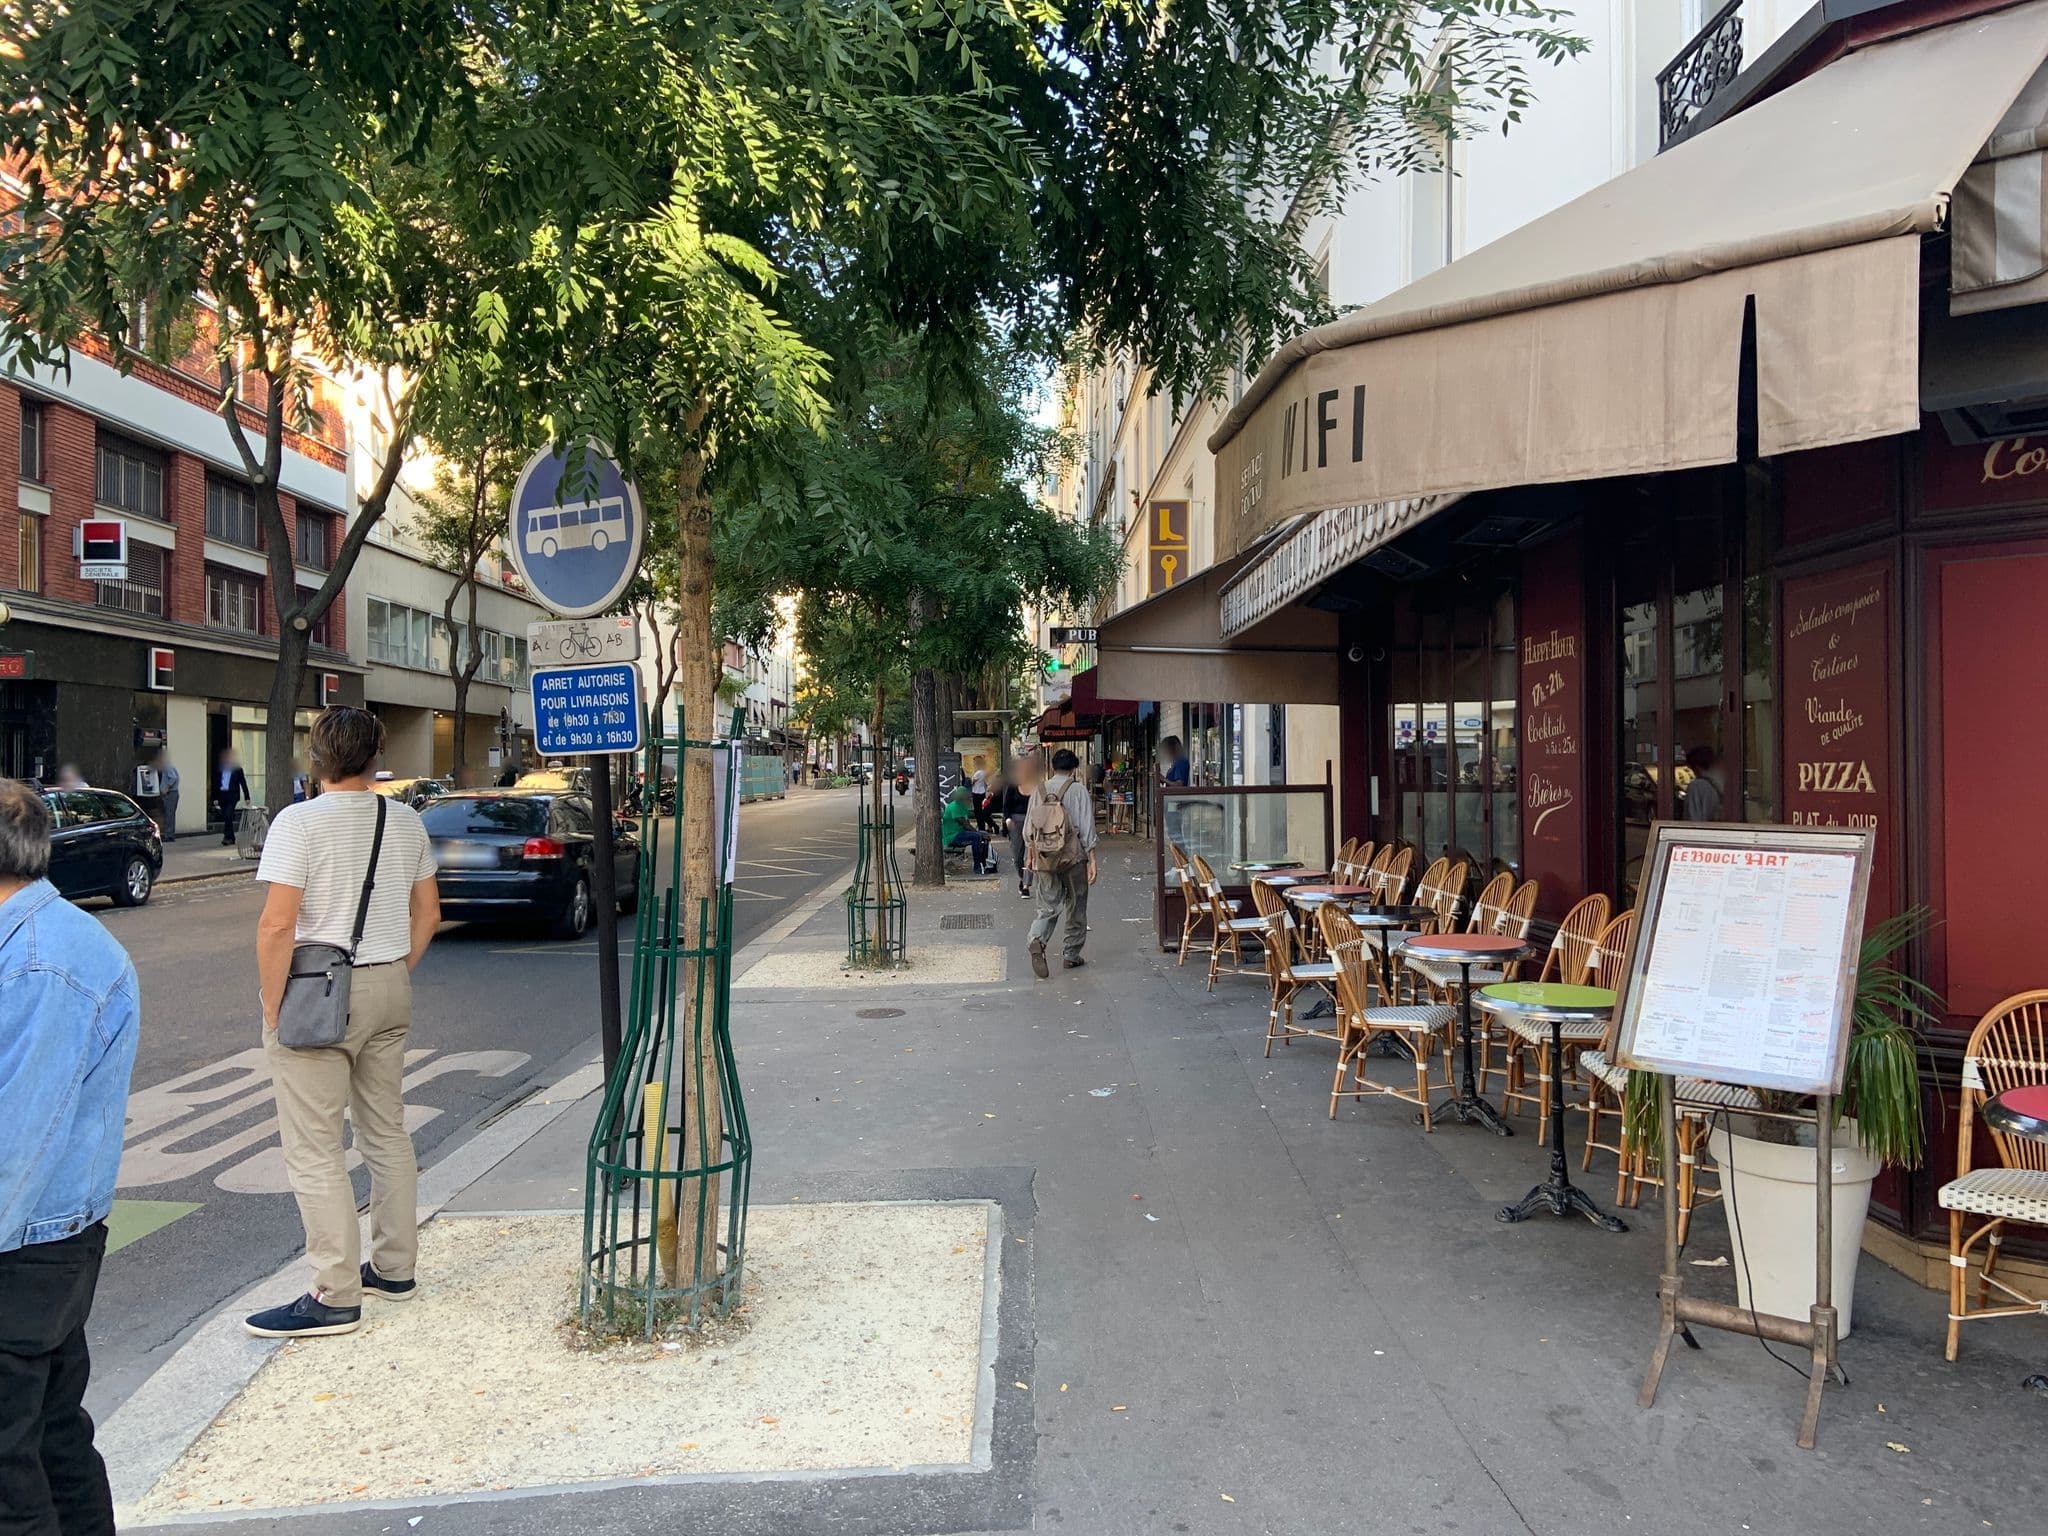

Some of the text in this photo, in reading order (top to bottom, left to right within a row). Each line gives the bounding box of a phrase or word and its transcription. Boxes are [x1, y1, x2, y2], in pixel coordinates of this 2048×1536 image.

[1281, 384, 1366, 480] WIFI
[1981, 437, 2048, 484] Co
[1790, 602, 1834, 639] Salades
[1068, 629, 1097, 641] PUB
[1829, 633, 1841, 650] &
[1810, 653, 1859, 682] Tartines
[542, 673, 626, 691] ARRET AUTORISE
[540, 692, 629, 710] POUR LIVRAISONS
[548, 711, 625, 728] de 19h30 à 7h30
[1805, 697, 1853, 724] Viande
[1528, 712, 1566, 743] Cocktails
[542, 730, 633, 746] et de 9h30 à 16h30
[1820, 732, 1830, 746] DE
[1798, 760, 1877, 793] PIZZA
[1528, 773, 1562, 808] Bières
[1793, 811, 1820, 826] PLAT
[1673, 851, 1688, 862] LE
